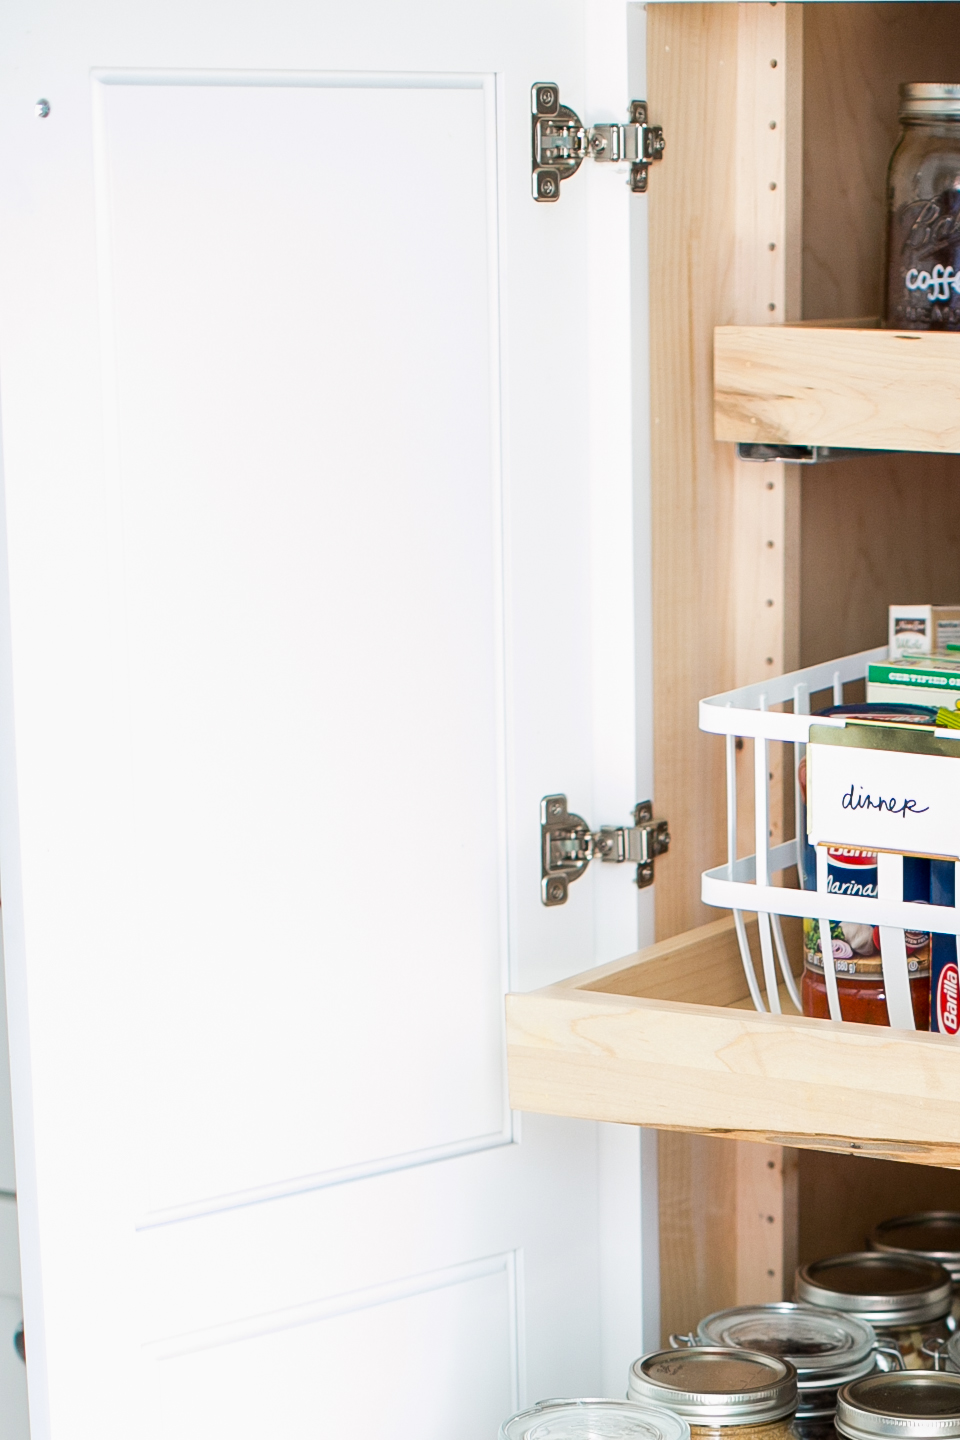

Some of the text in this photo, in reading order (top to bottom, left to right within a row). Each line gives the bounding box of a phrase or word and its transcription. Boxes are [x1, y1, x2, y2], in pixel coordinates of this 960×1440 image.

[888, 672, 948, 686] CERTIFIED
[841, 784, 931, 818] dinner
[943, 969, 959, 1030] Barilla
